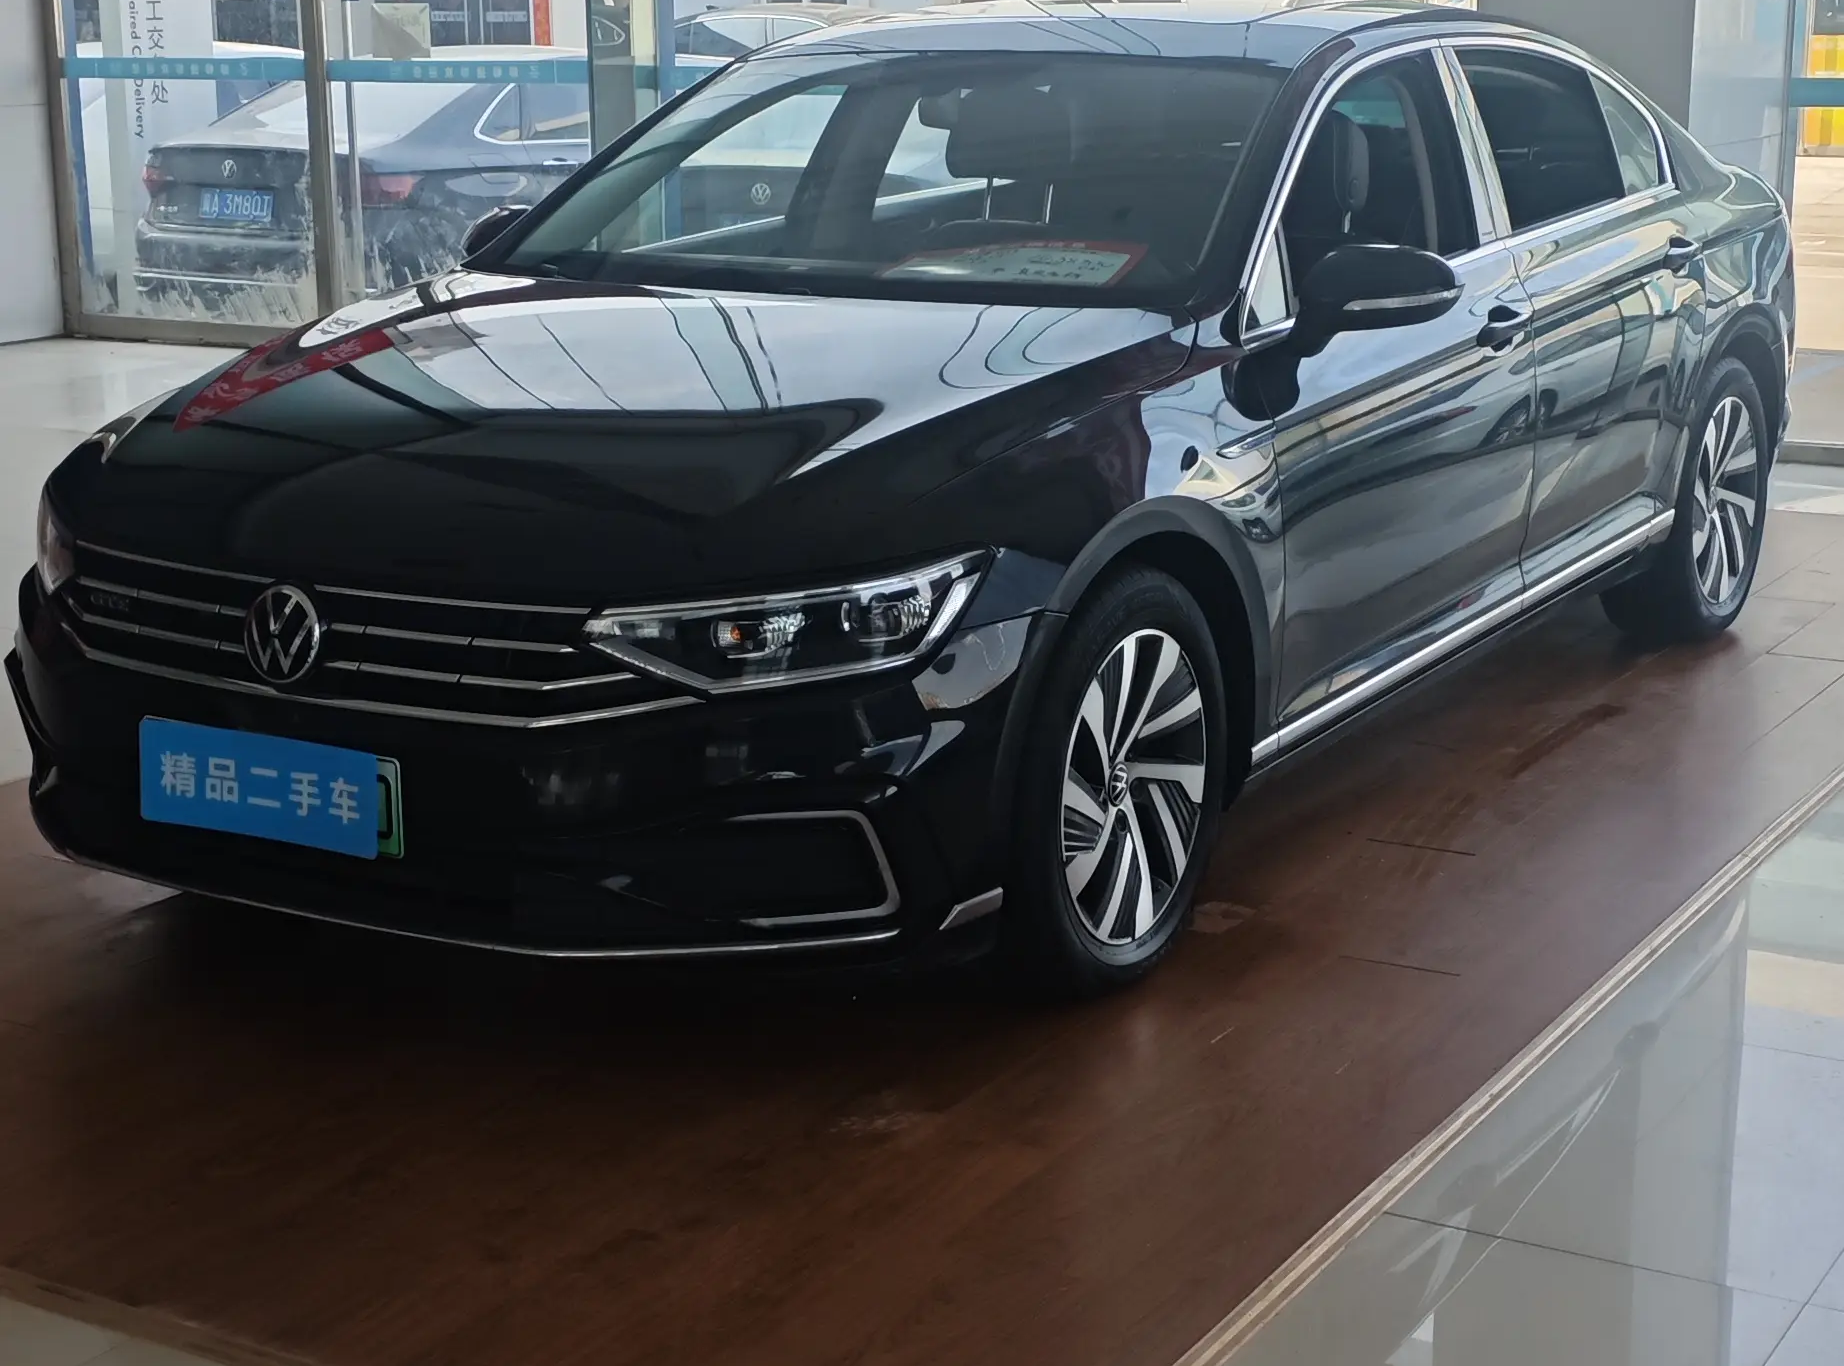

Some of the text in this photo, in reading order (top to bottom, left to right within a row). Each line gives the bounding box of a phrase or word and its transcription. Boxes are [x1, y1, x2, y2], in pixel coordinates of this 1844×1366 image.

[160, 750, 361, 825] 精品二手车
